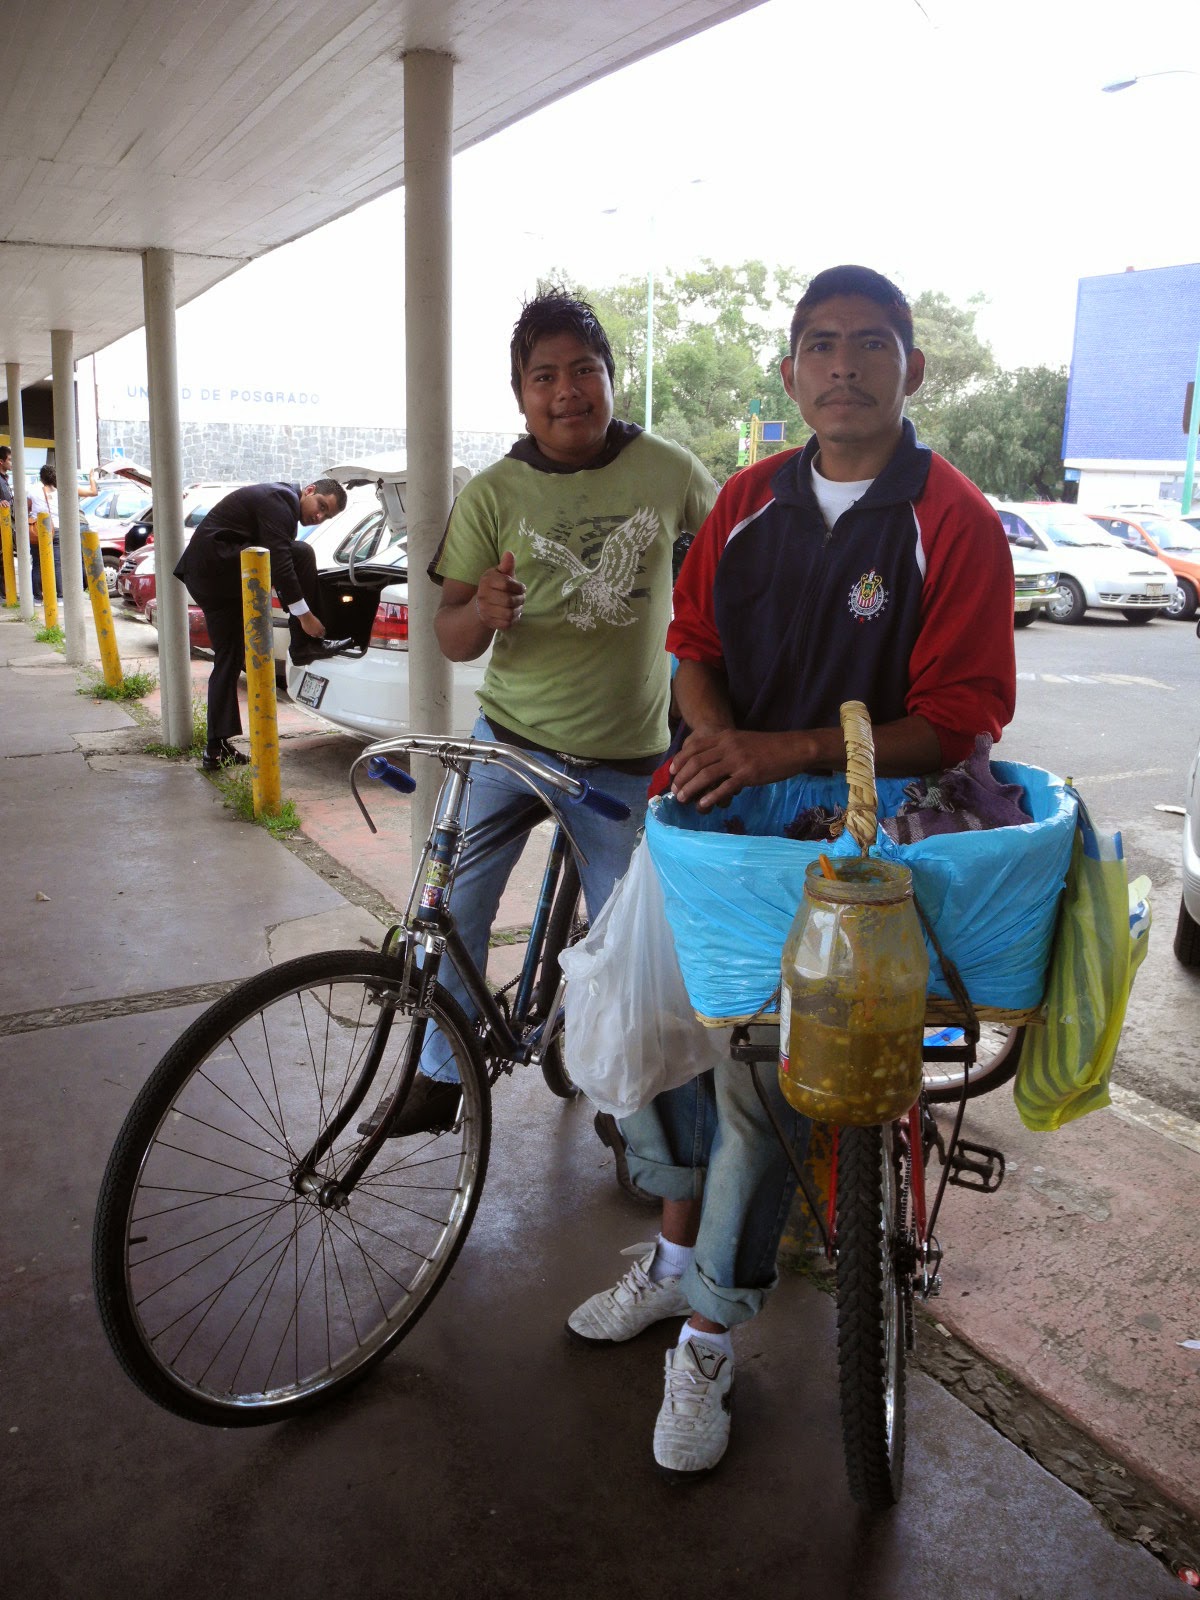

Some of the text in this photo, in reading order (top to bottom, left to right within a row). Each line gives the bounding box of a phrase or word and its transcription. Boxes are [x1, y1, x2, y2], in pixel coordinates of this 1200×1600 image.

[127, 385, 320, 405] UND DE POSGRADO
